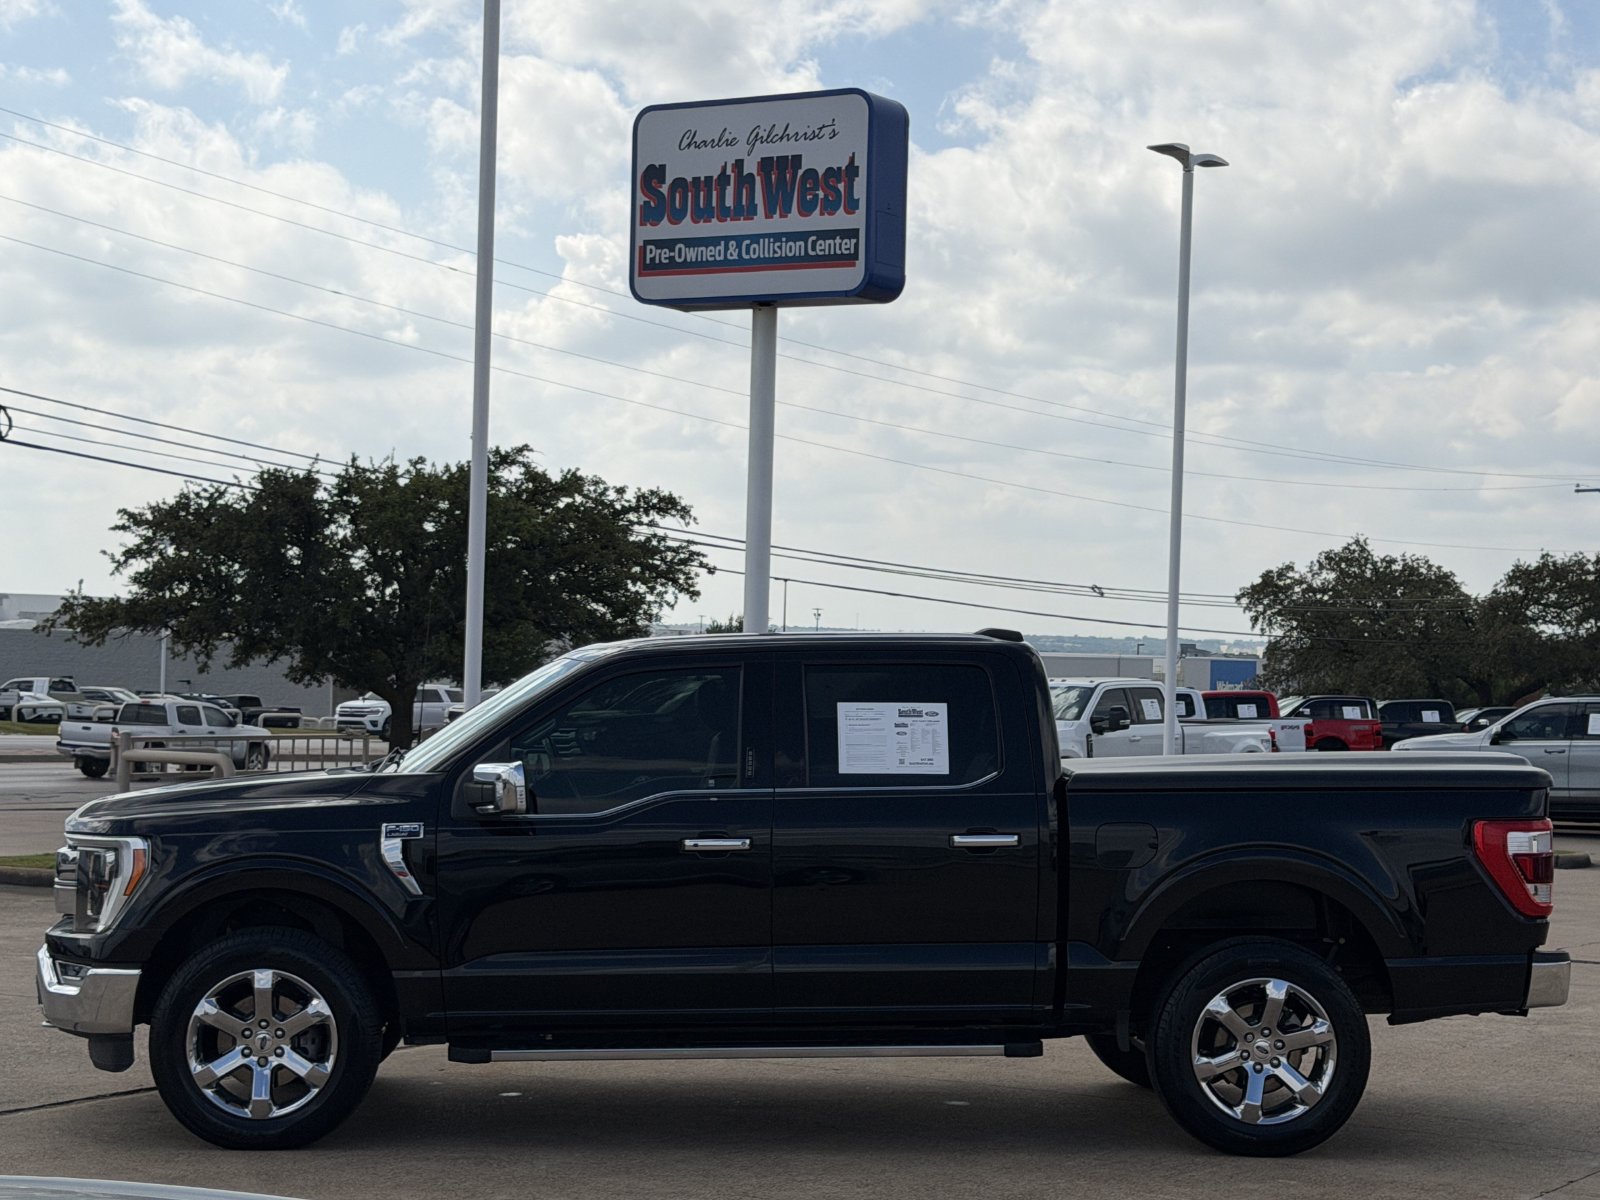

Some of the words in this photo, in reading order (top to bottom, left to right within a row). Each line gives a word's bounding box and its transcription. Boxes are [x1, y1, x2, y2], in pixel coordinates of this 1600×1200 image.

[678, 127, 740, 151] Charlie
[746, 118, 840, 156] Gilchrist's
[639, 152, 860, 226] SouthWest
[645, 239, 725, 264] Pre-Owned
[726, 240, 738, 259] &
[741, 236, 805, 259] Collision
[807, 234, 857, 256] Center
